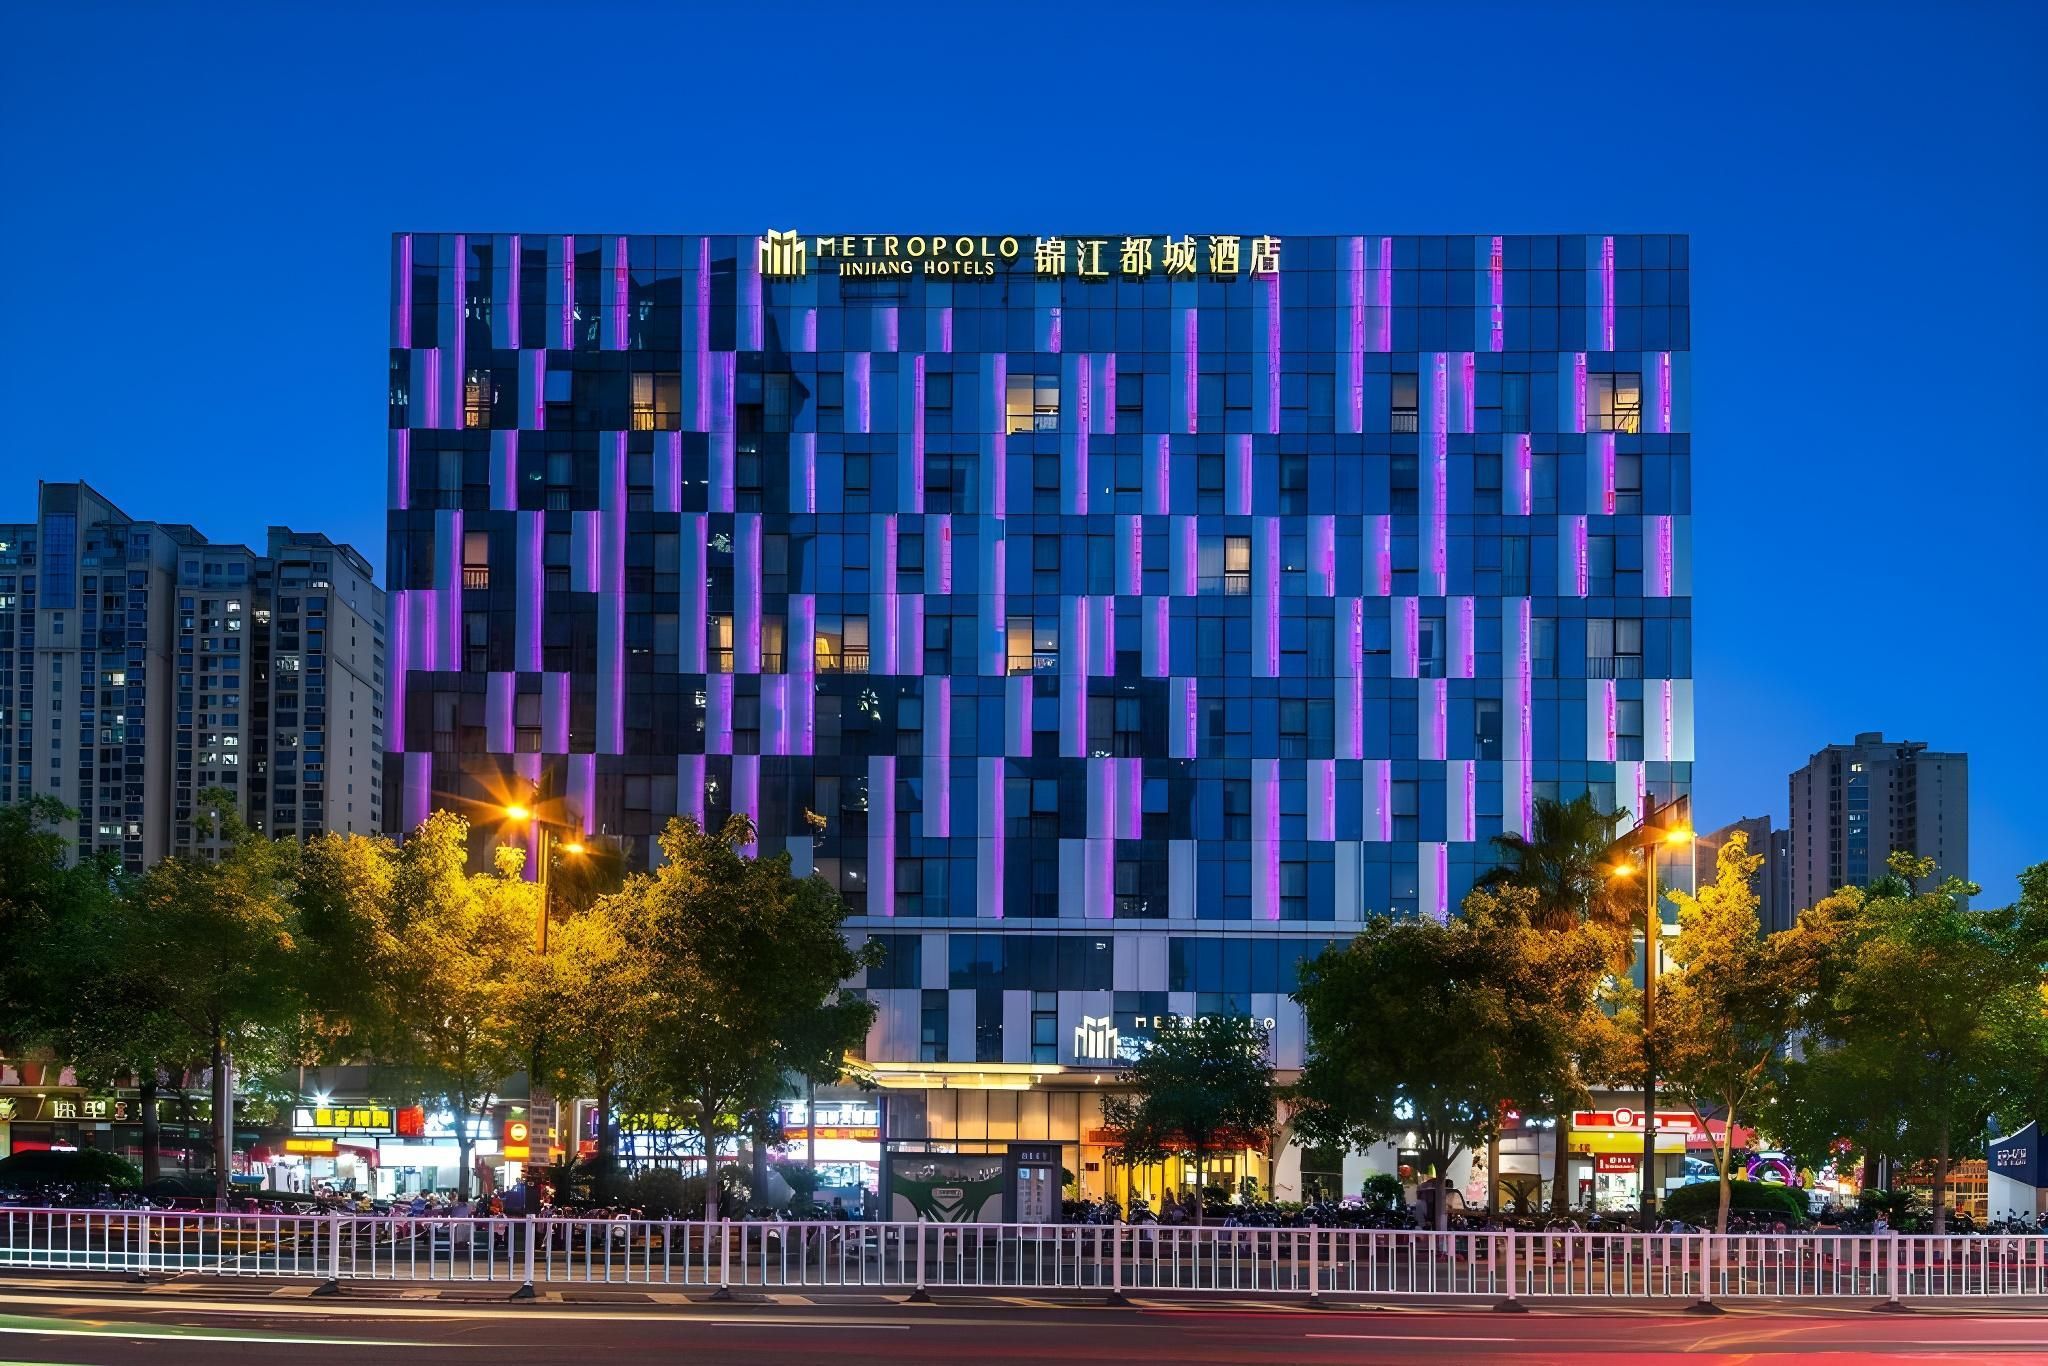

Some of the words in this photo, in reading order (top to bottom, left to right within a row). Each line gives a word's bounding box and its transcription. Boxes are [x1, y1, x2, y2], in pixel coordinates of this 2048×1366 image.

[816, 236, 1019, 257] METROPOLO
[1034, 235, 1281, 276] 锦江都城酒店
[839, 261, 913, 276] JINJIANG
[924, 261, 994, 275] HOTELS
[1135, 1016, 1275, 1030] METROLO
